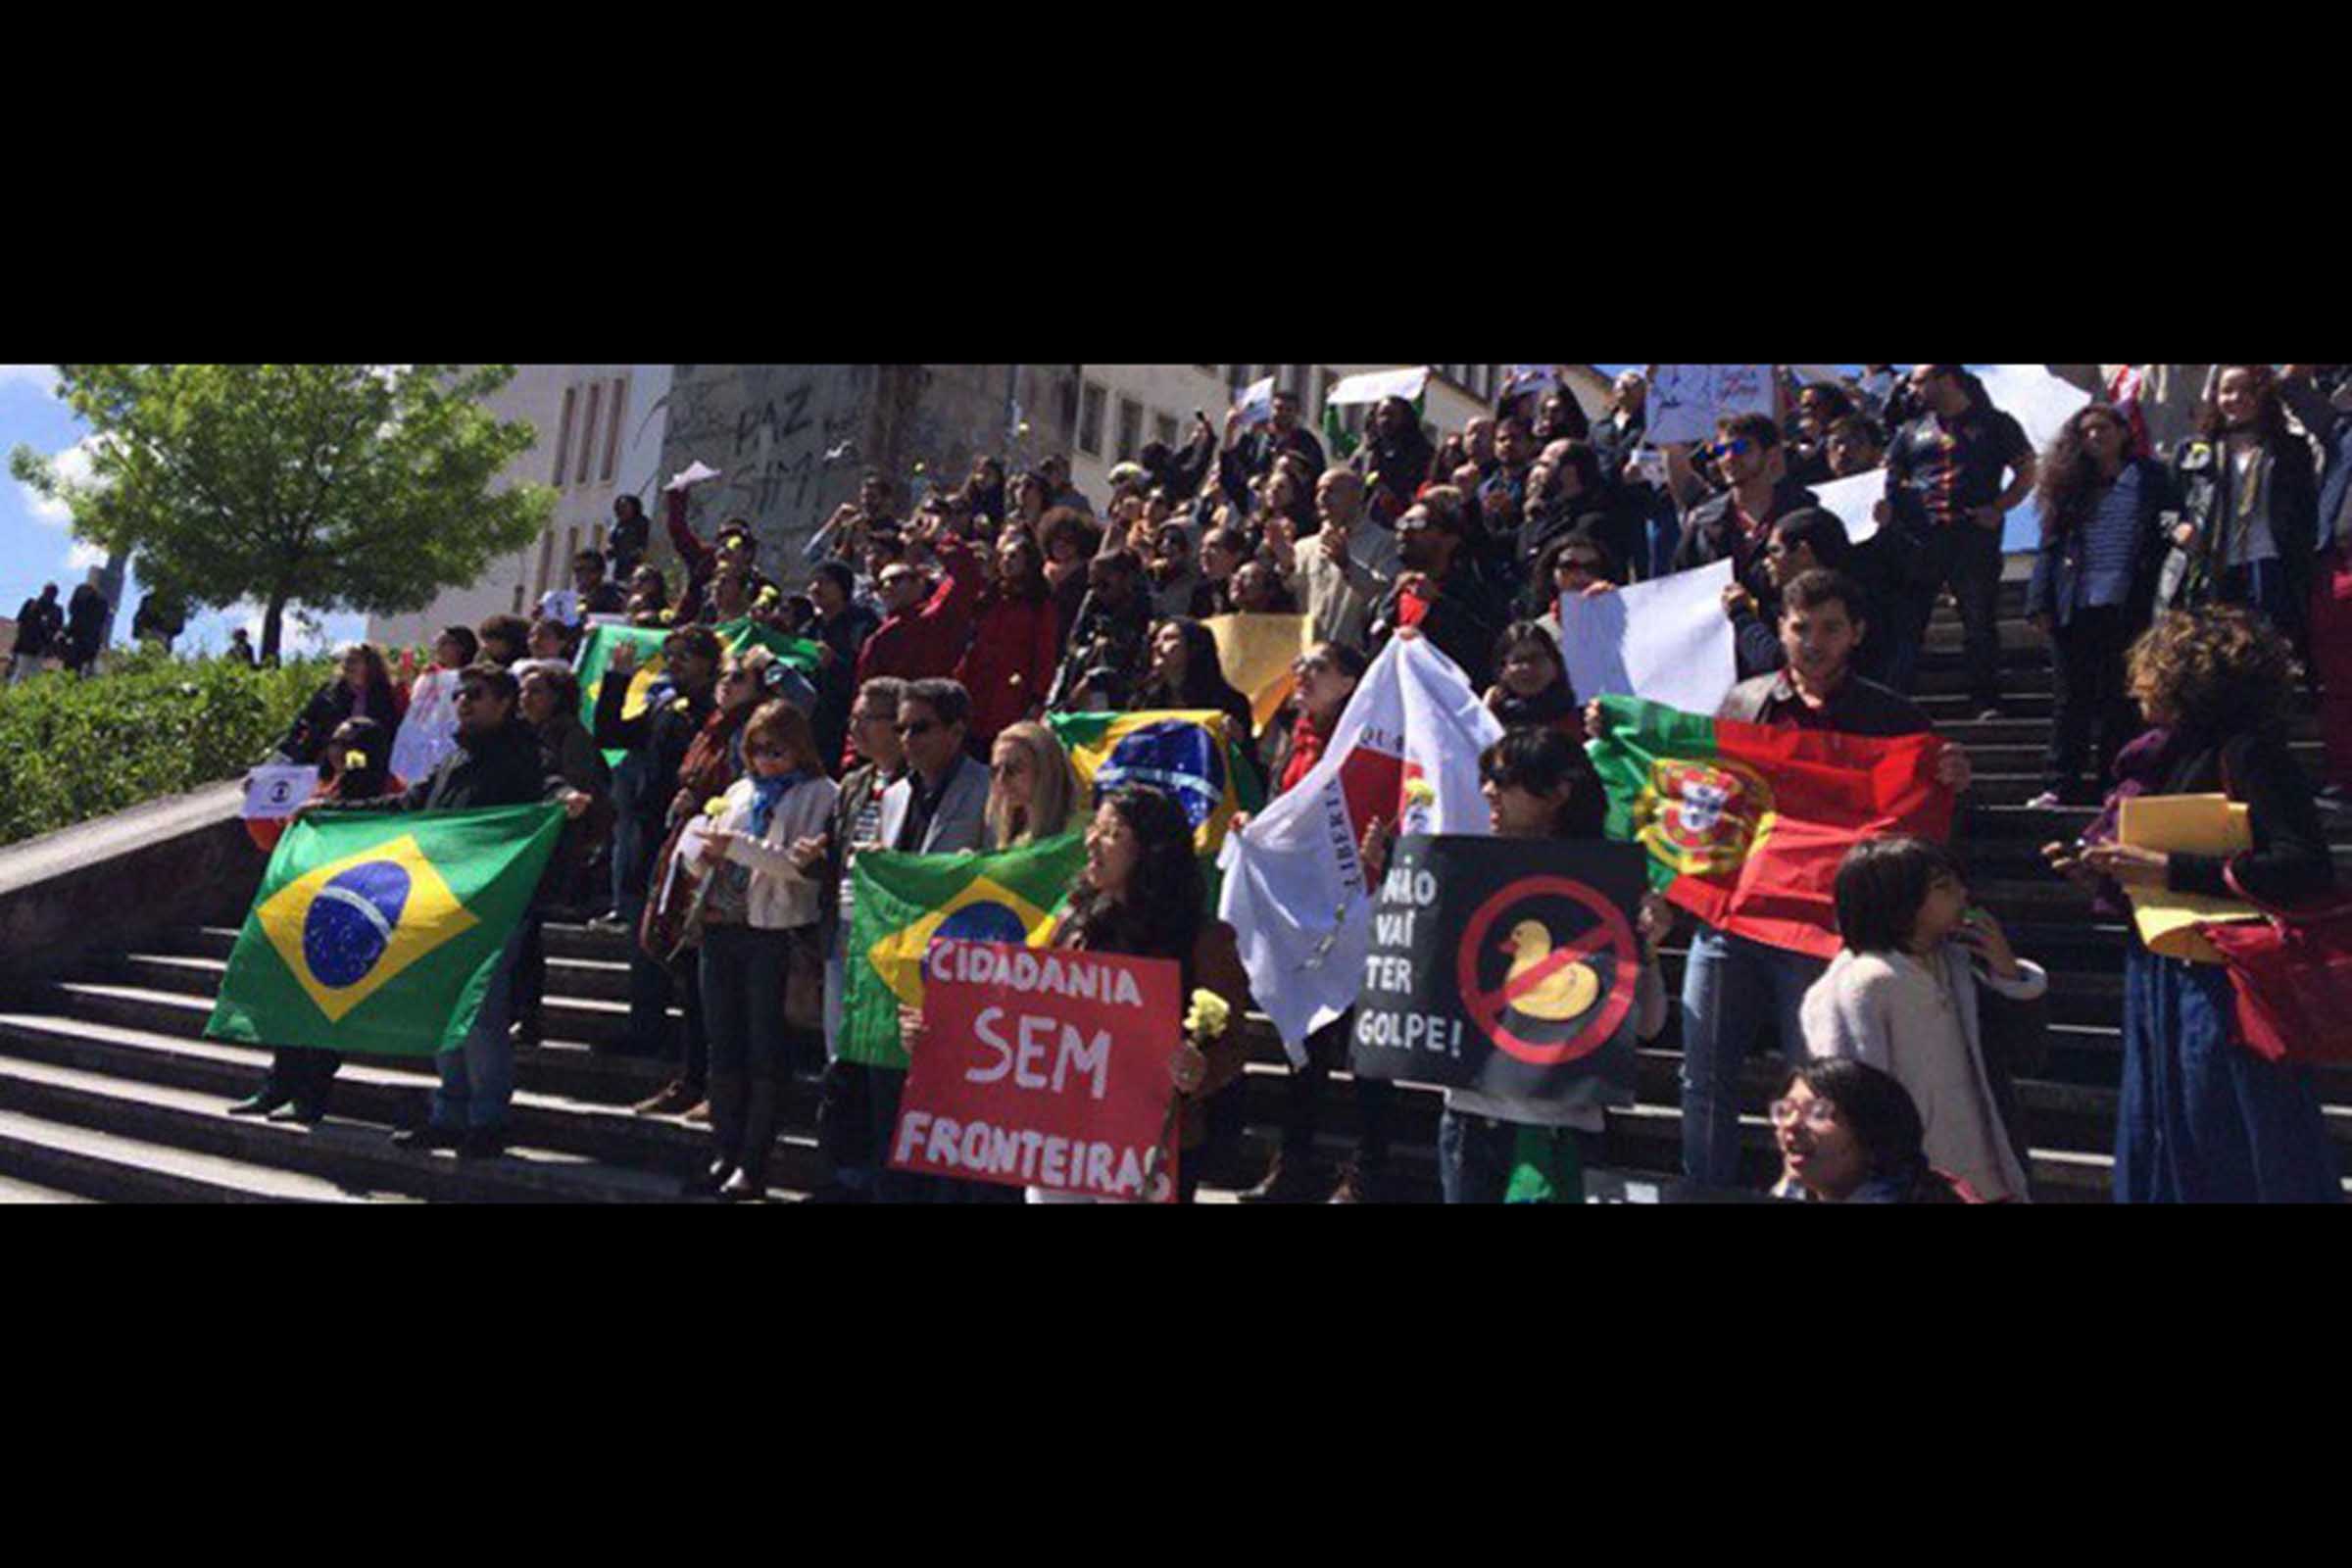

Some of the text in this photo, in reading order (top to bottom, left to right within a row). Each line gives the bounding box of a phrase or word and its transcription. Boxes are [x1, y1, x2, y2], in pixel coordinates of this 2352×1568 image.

[1382, 854, 1438, 906] NÃO
[930, 939, 1144, 1007] CIDADANIA
[1365, 956, 1412, 995] TER
[965, 1005, 1112, 1101] SEM
[1356, 1008, 1464, 1058] GOLPE!
[894, 1110, 1172, 1203] FRONTEIRAS
